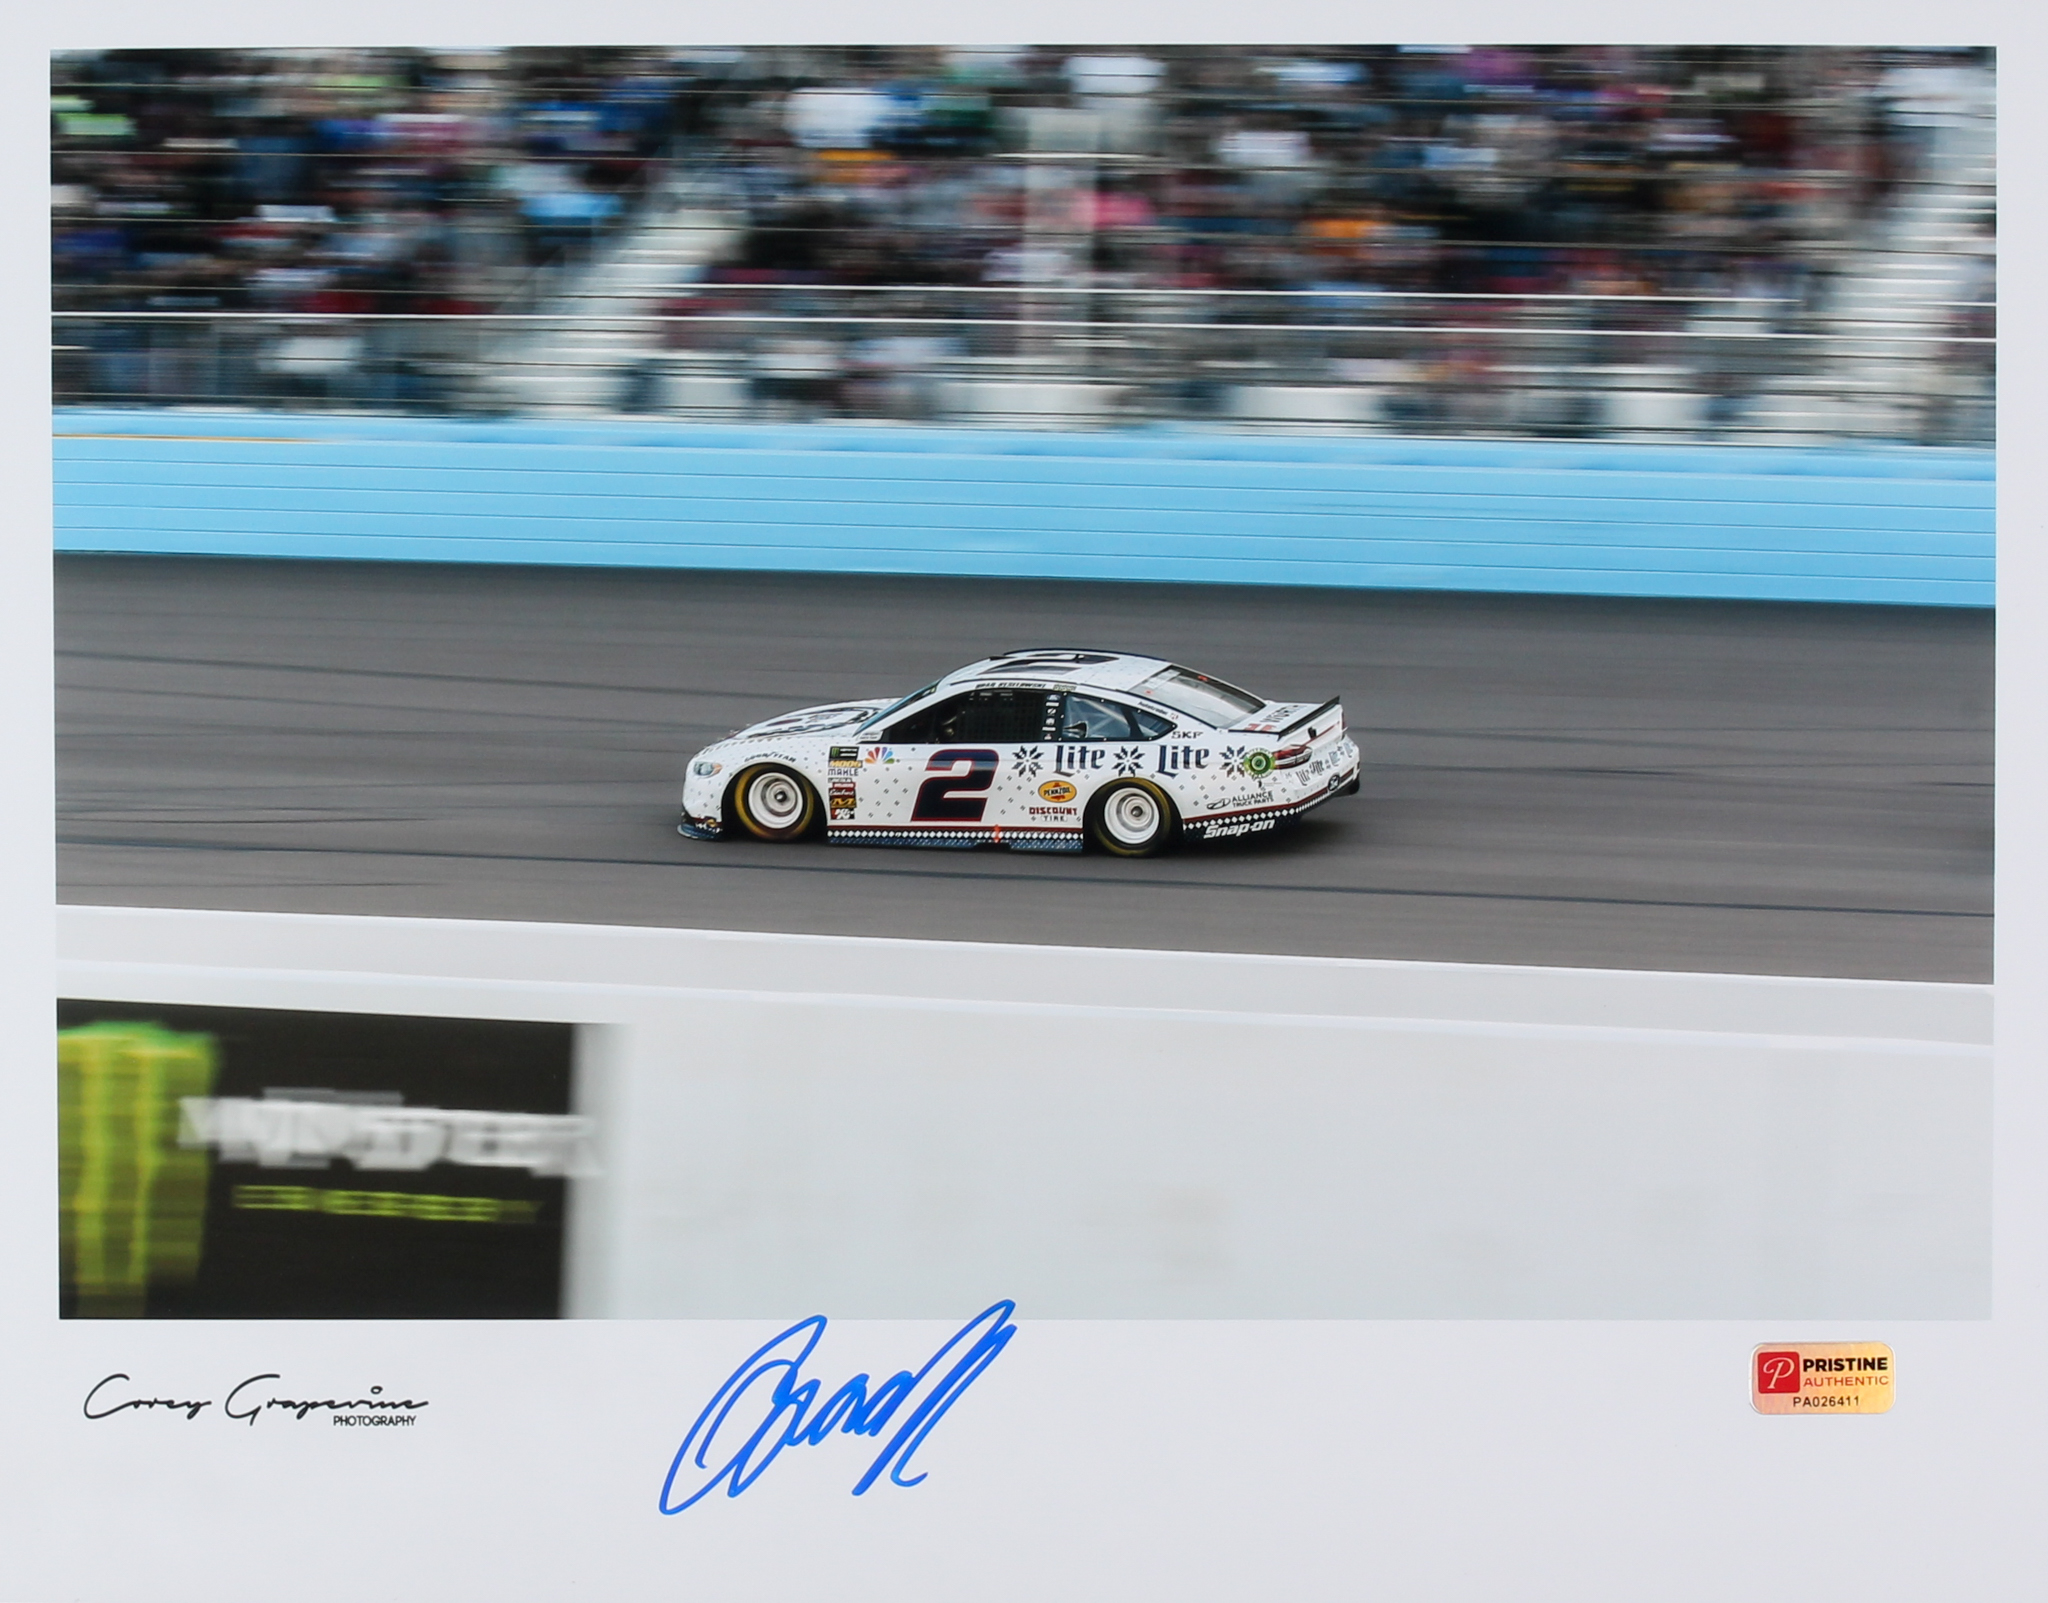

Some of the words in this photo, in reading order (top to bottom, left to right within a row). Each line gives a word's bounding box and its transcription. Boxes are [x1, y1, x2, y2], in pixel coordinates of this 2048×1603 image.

[1053, 745, 1105, 777] Lite
[1156, 745, 1209, 778] Lite
[911, 749, 999, 822] 2
[1232, 790, 1273, 802] ALLIANCE
[1253, 797, 1274, 805] PARTS
[1029, 806, 1077, 815] DISCOUNT
[1203, 819, 1275, 839] Snap-on
[1803, 1357, 1888, 1372] PRISTINE
[1803, 1375, 1889, 1388] AUTHENTIC
[83, 1373, 213, 1420] Corey
[225, 1373, 429, 1426] Grapevine
[1793, 1396, 1859, 1407] PA026411
[333, 1415, 417, 1426] PHOTOGRAPHY
